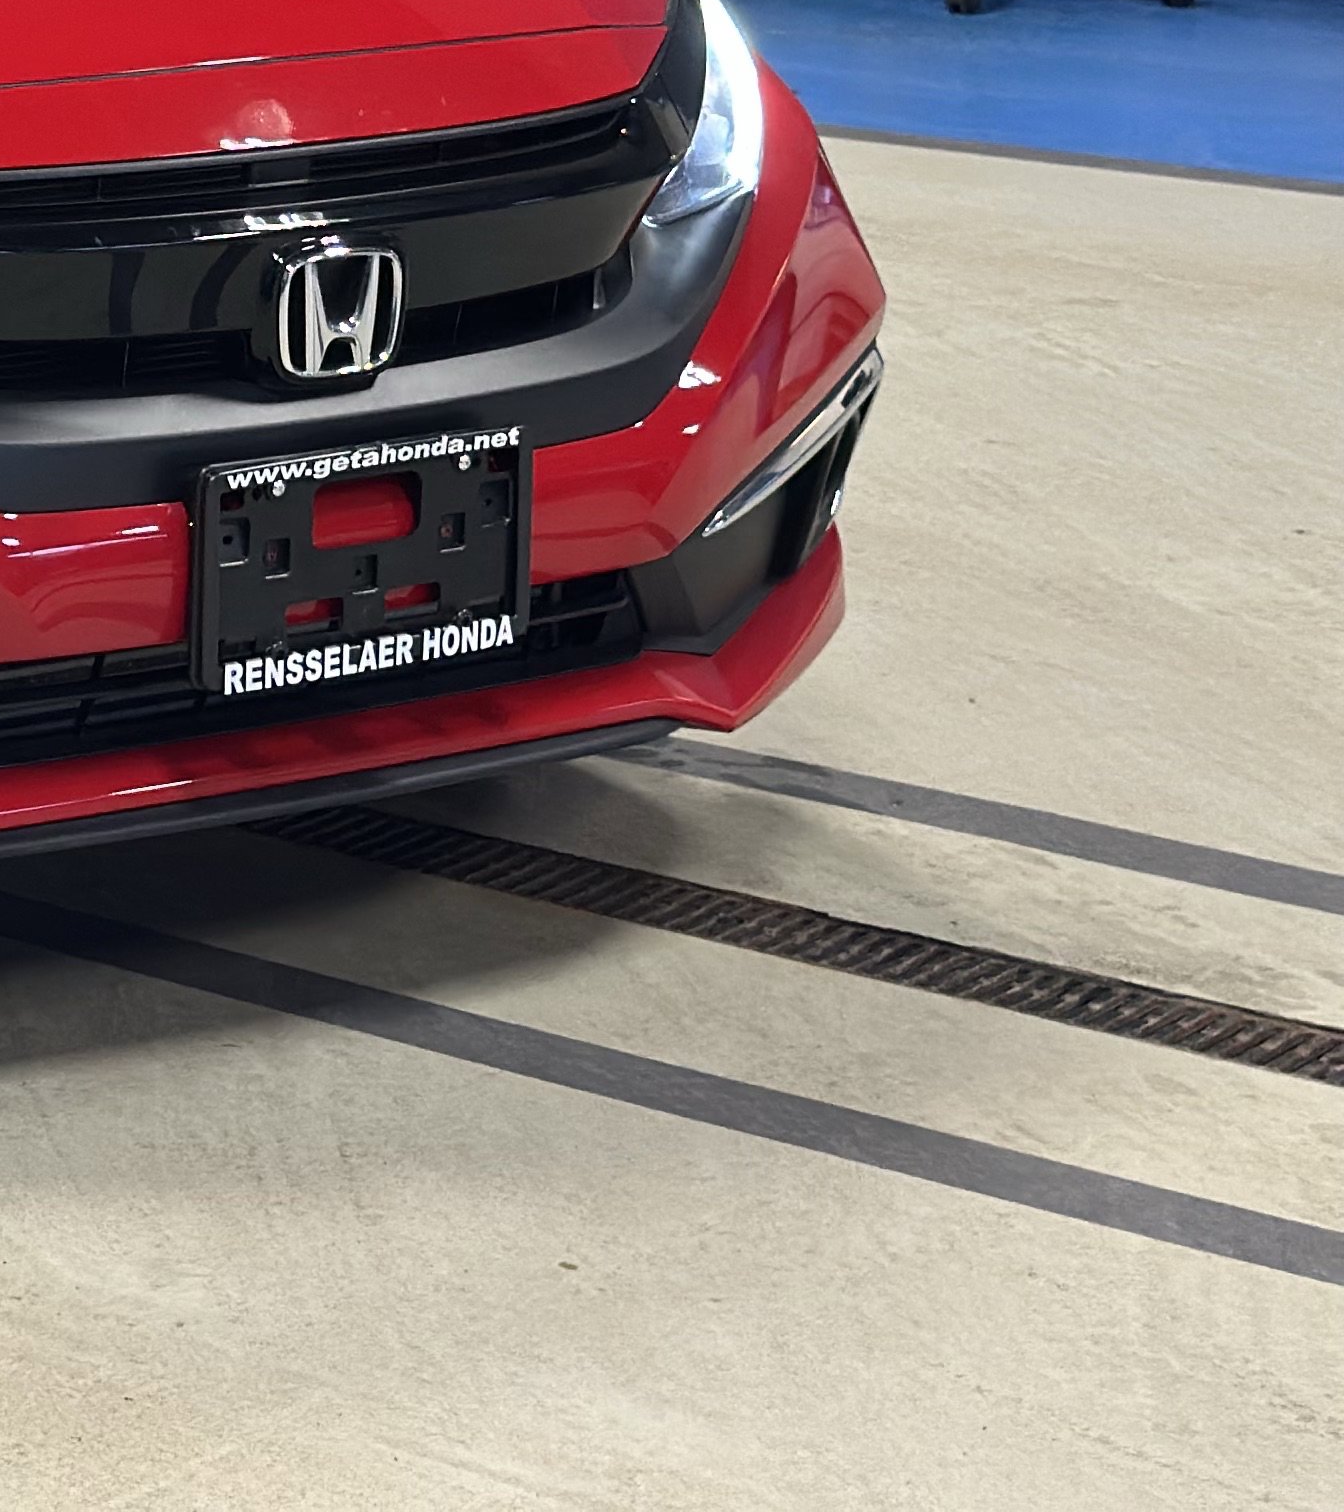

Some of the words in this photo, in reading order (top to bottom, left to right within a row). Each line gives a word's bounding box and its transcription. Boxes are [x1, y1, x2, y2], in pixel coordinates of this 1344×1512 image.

[226, 426, 520, 490] www.getahonda.net
[223, 633, 414, 696] RENSSELAER
[422, 614, 515, 661] HONDA
